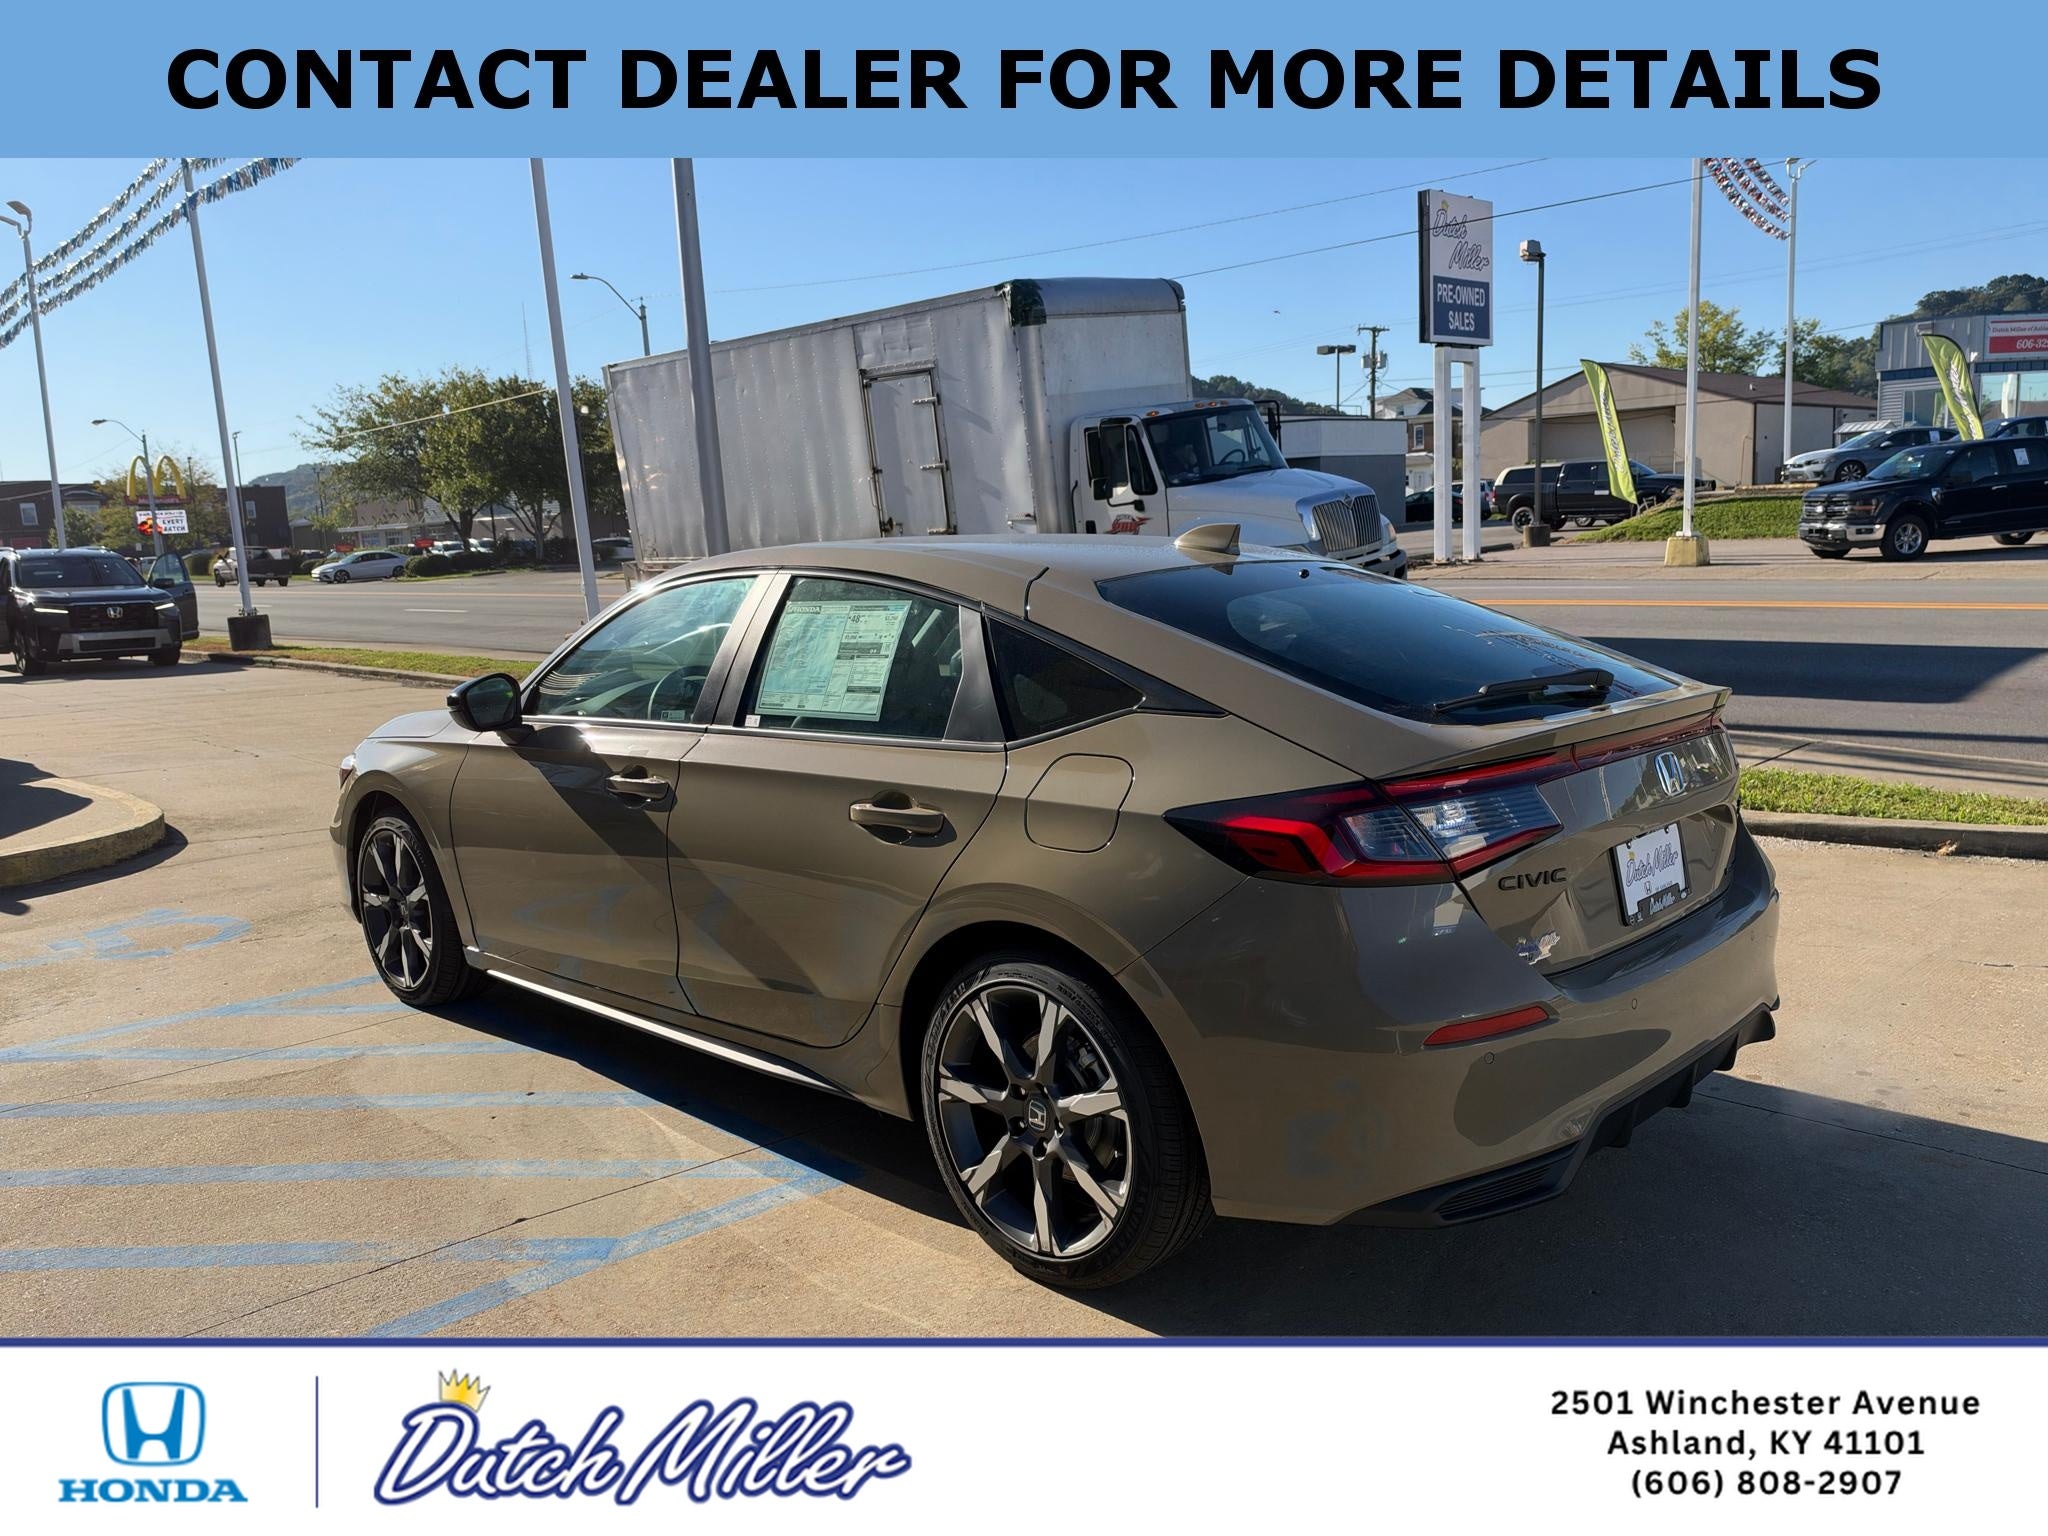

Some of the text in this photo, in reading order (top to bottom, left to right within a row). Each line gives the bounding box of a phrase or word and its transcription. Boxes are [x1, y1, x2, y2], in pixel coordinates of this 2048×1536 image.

[1433, 208, 1468, 239] Dutch
[1448, 240, 1490, 272] Miller
[1436, 283, 1486, 307] PRE-OWNED
[1448, 310, 1475, 331] SALES
[1626, 842, 1679, 887] Dutch Miller
[1498, 868, 1567, 891] CIVIC
